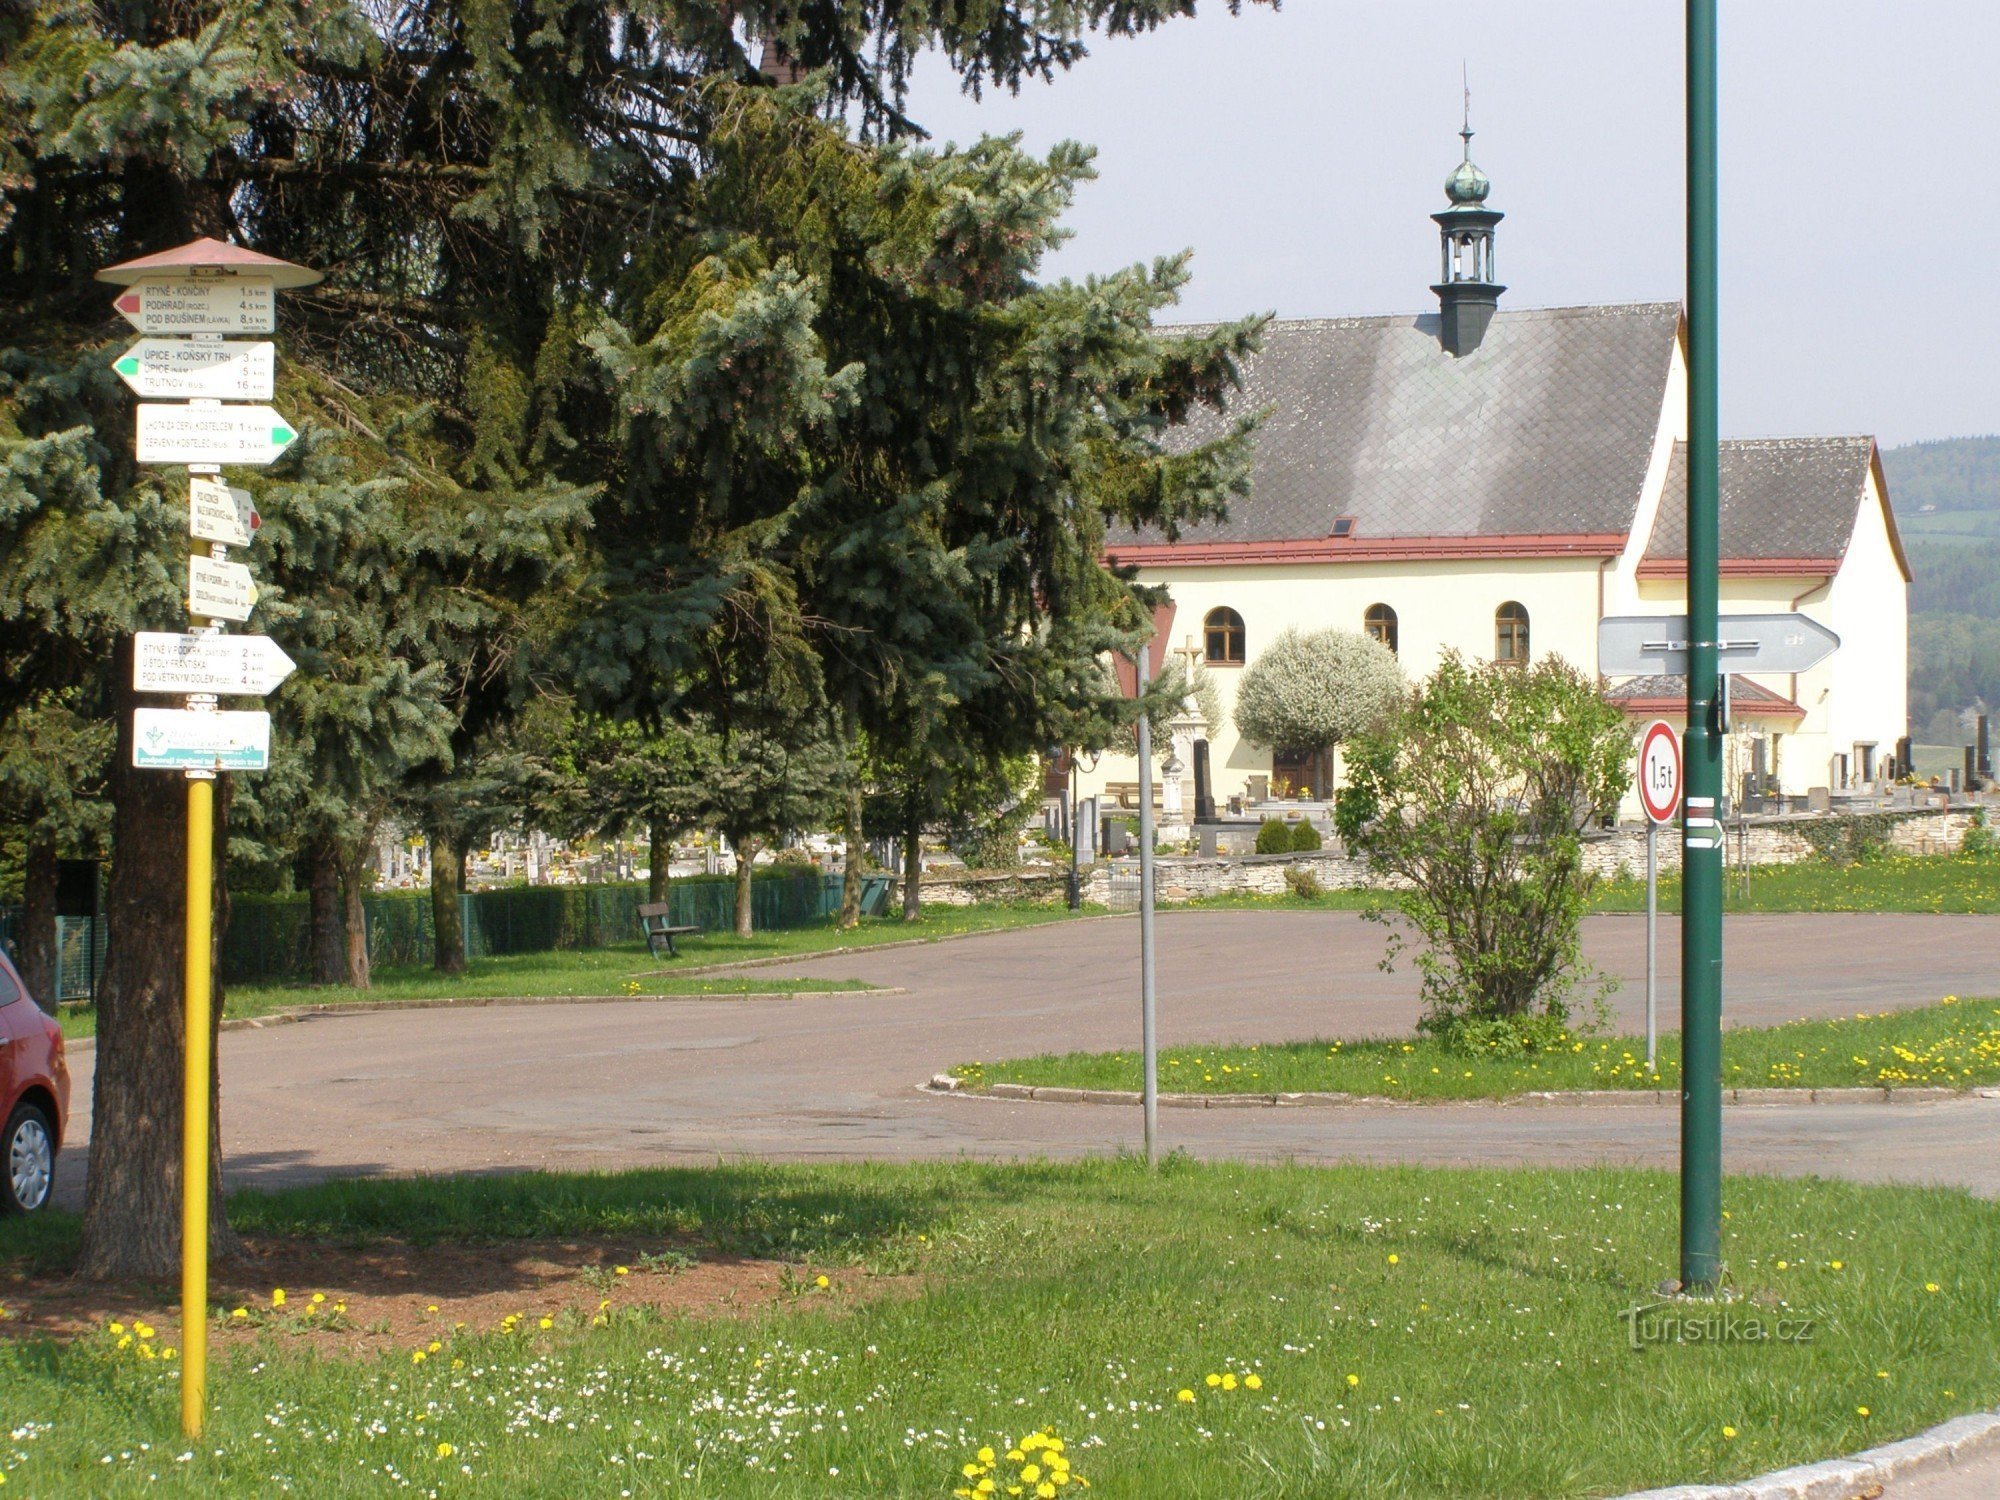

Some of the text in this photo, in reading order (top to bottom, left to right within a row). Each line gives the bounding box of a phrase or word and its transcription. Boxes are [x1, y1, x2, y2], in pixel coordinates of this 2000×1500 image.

[146, 285, 171, 297] RTYNĚ
[177, 285, 210, 297] KONČINY
[240, 287, 253, 297] 1,5
[146, 299, 186, 311] PODHRADÍ
[239, 301, 253, 311] 4,5
[146, 314, 163, 324] POD
[240, 314, 253, 324] 8,5
[145, 350, 169, 361] ÚPICE
[177, 350, 211, 362] KOŇSKÝ
[215, 353, 231, 362] TRH
[243, 353, 249, 362] 3
[243, 367, 249, 376] 5
[145, 378, 183, 389] TRUTNOV
[237, 380, 249, 390] 16
[242, 648, 248, 657] 2
[242, 662, 248, 671] 3
[241, 676, 247, 684] 4
